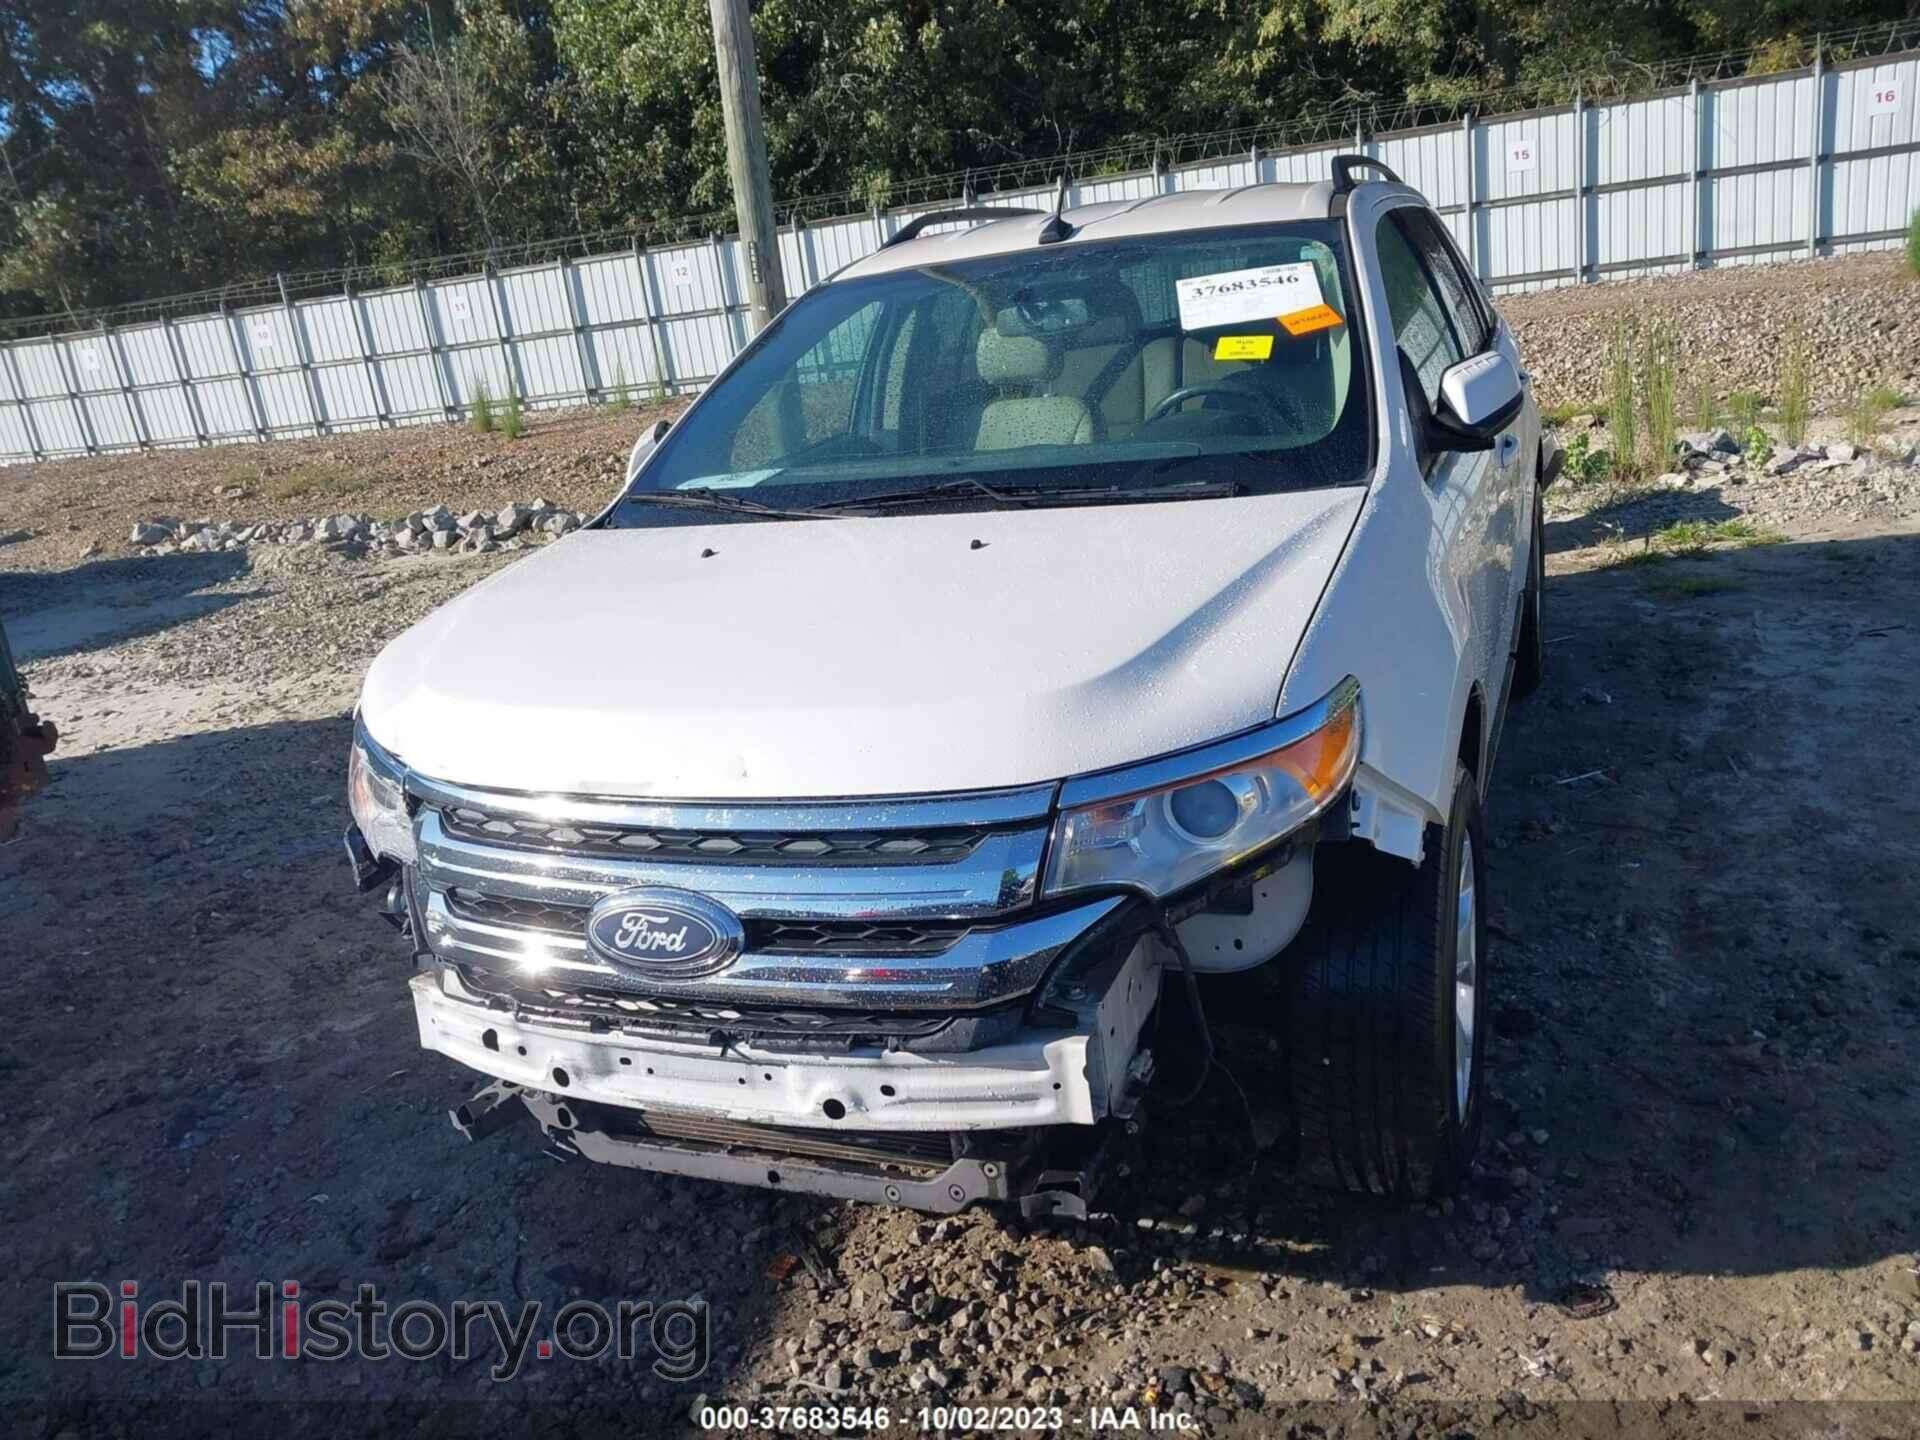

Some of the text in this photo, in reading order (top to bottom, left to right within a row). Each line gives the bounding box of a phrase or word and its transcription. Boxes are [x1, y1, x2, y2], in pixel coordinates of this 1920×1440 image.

[1875, 90, 1896, 103] 16
[1513, 150, 1530, 161] 15
[676, 266, 688, 276] 12
[1191, 273, 1300, 299] 37683546
[614, 912, 689, 953] Ford
